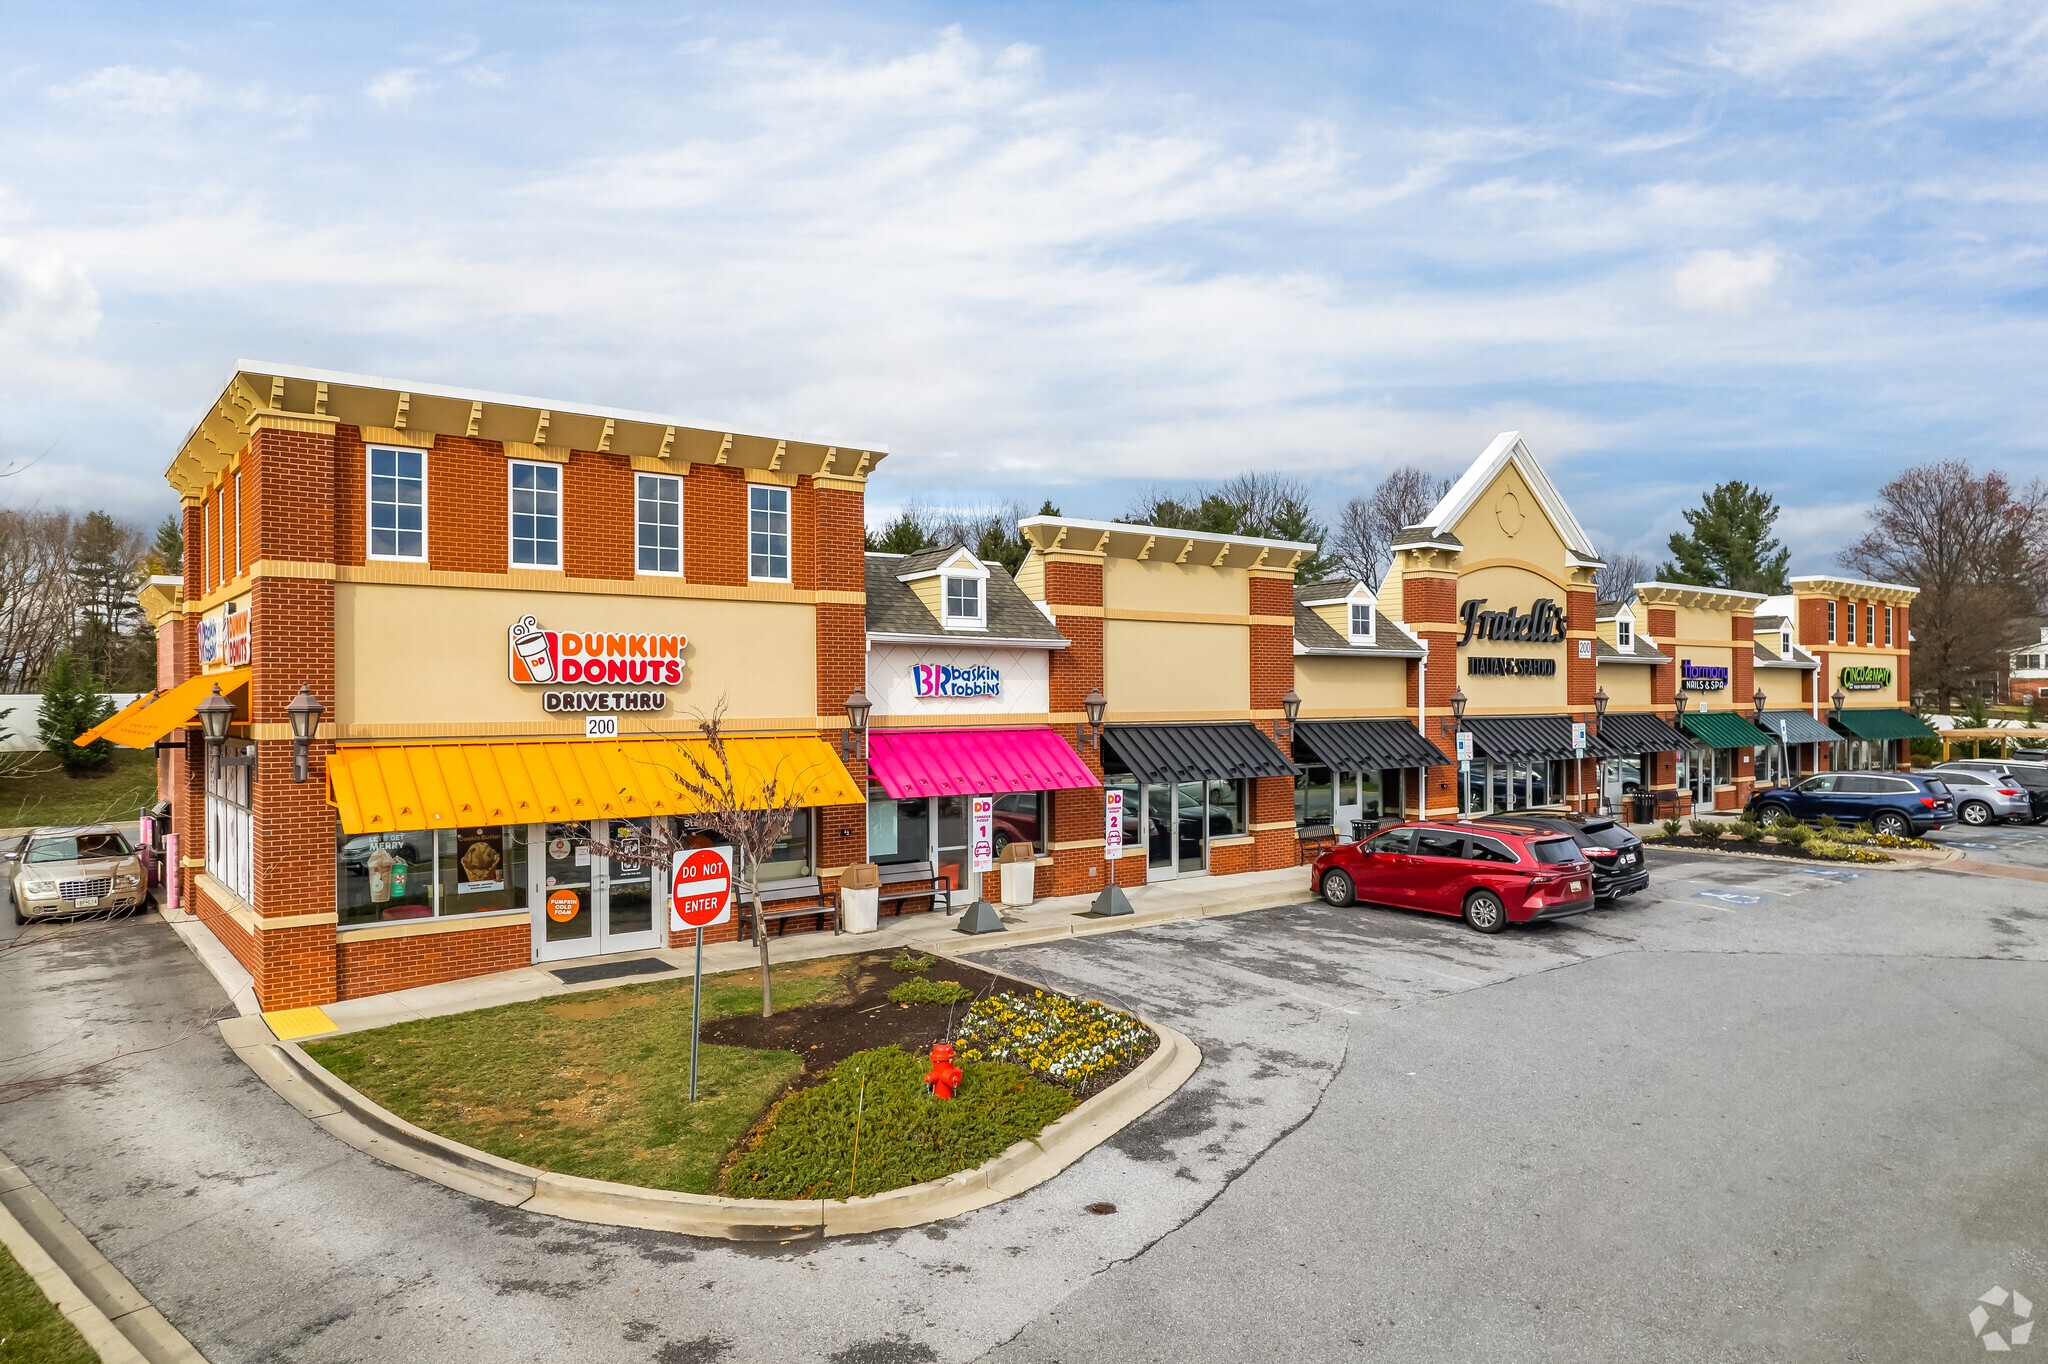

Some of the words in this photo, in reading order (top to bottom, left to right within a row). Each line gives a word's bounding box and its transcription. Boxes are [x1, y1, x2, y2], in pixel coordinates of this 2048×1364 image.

[1457, 598, 1568, 647] Fratelli's
[562, 632, 687, 658] DUNKIN'
[1579, 641, 1591, 654] 200
[530, 656, 545, 667] DD
[1468, 657, 1506, 676] ITALIAN
[1516, 658, 1556, 676] SEAFOOD
[562, 658, 681, 683] DONUTS
[951, 665, 1000, 682] baskin
[951, 681, 1000, 696] robbins
[1686, 680, 1704, 690] NAILS
[1704, 680, 1710, 690] &
[1710, 680, 1724, 690] SPA
[546, 693, 610, 710] DRIVE
[611, 693, 665, 709] THRU
[588, 719, 615, 735] 200
[1107, 794, 1122, 804] DD
[974, 801, 991, 813] DD
[1110, 816, 1118, 828] 2
[390, 833, 405, 841] GET
[979, 825, 986, 838] 1
[682, 865, 697, 878] DO
[702, 862, 723, 876] NOT
[684, 897, 718, 913] ENTER
